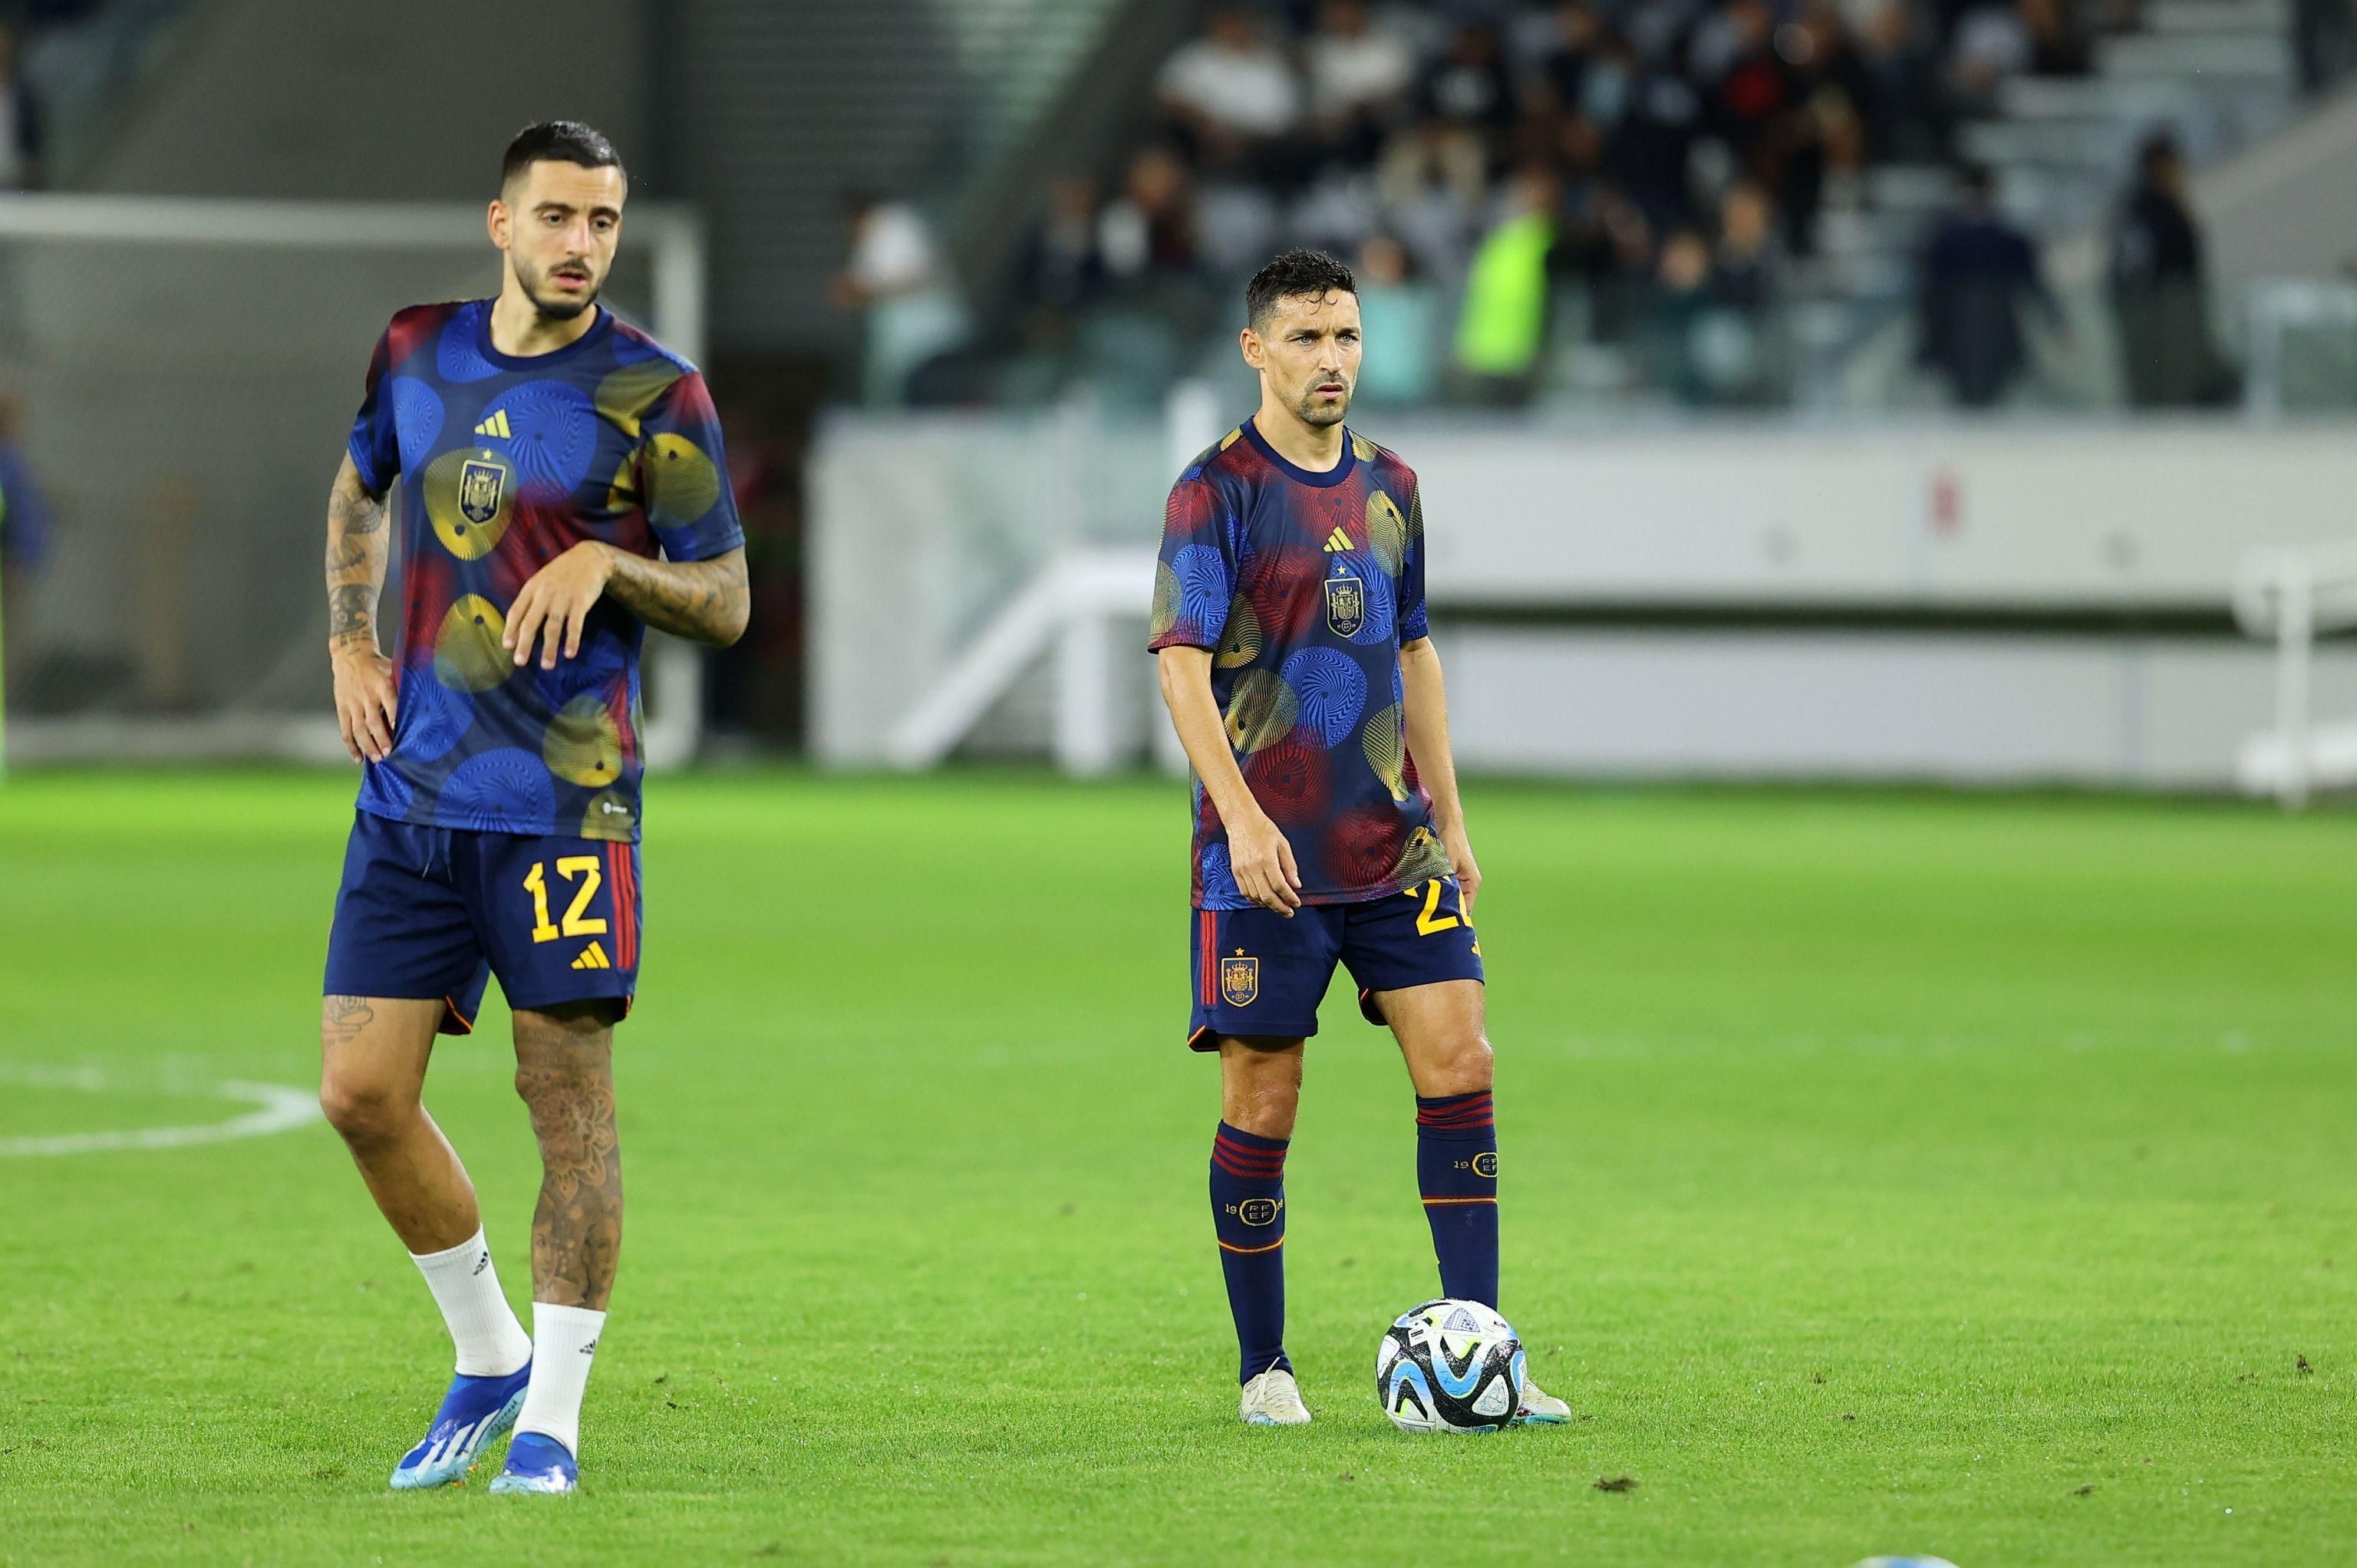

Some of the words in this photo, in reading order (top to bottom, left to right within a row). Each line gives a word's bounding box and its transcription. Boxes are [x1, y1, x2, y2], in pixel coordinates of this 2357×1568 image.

[522, 855, 608, 944] 12
[1453, 1161, 1469, 1169] 19
[1225, 1204, 1237, 1214] 19
